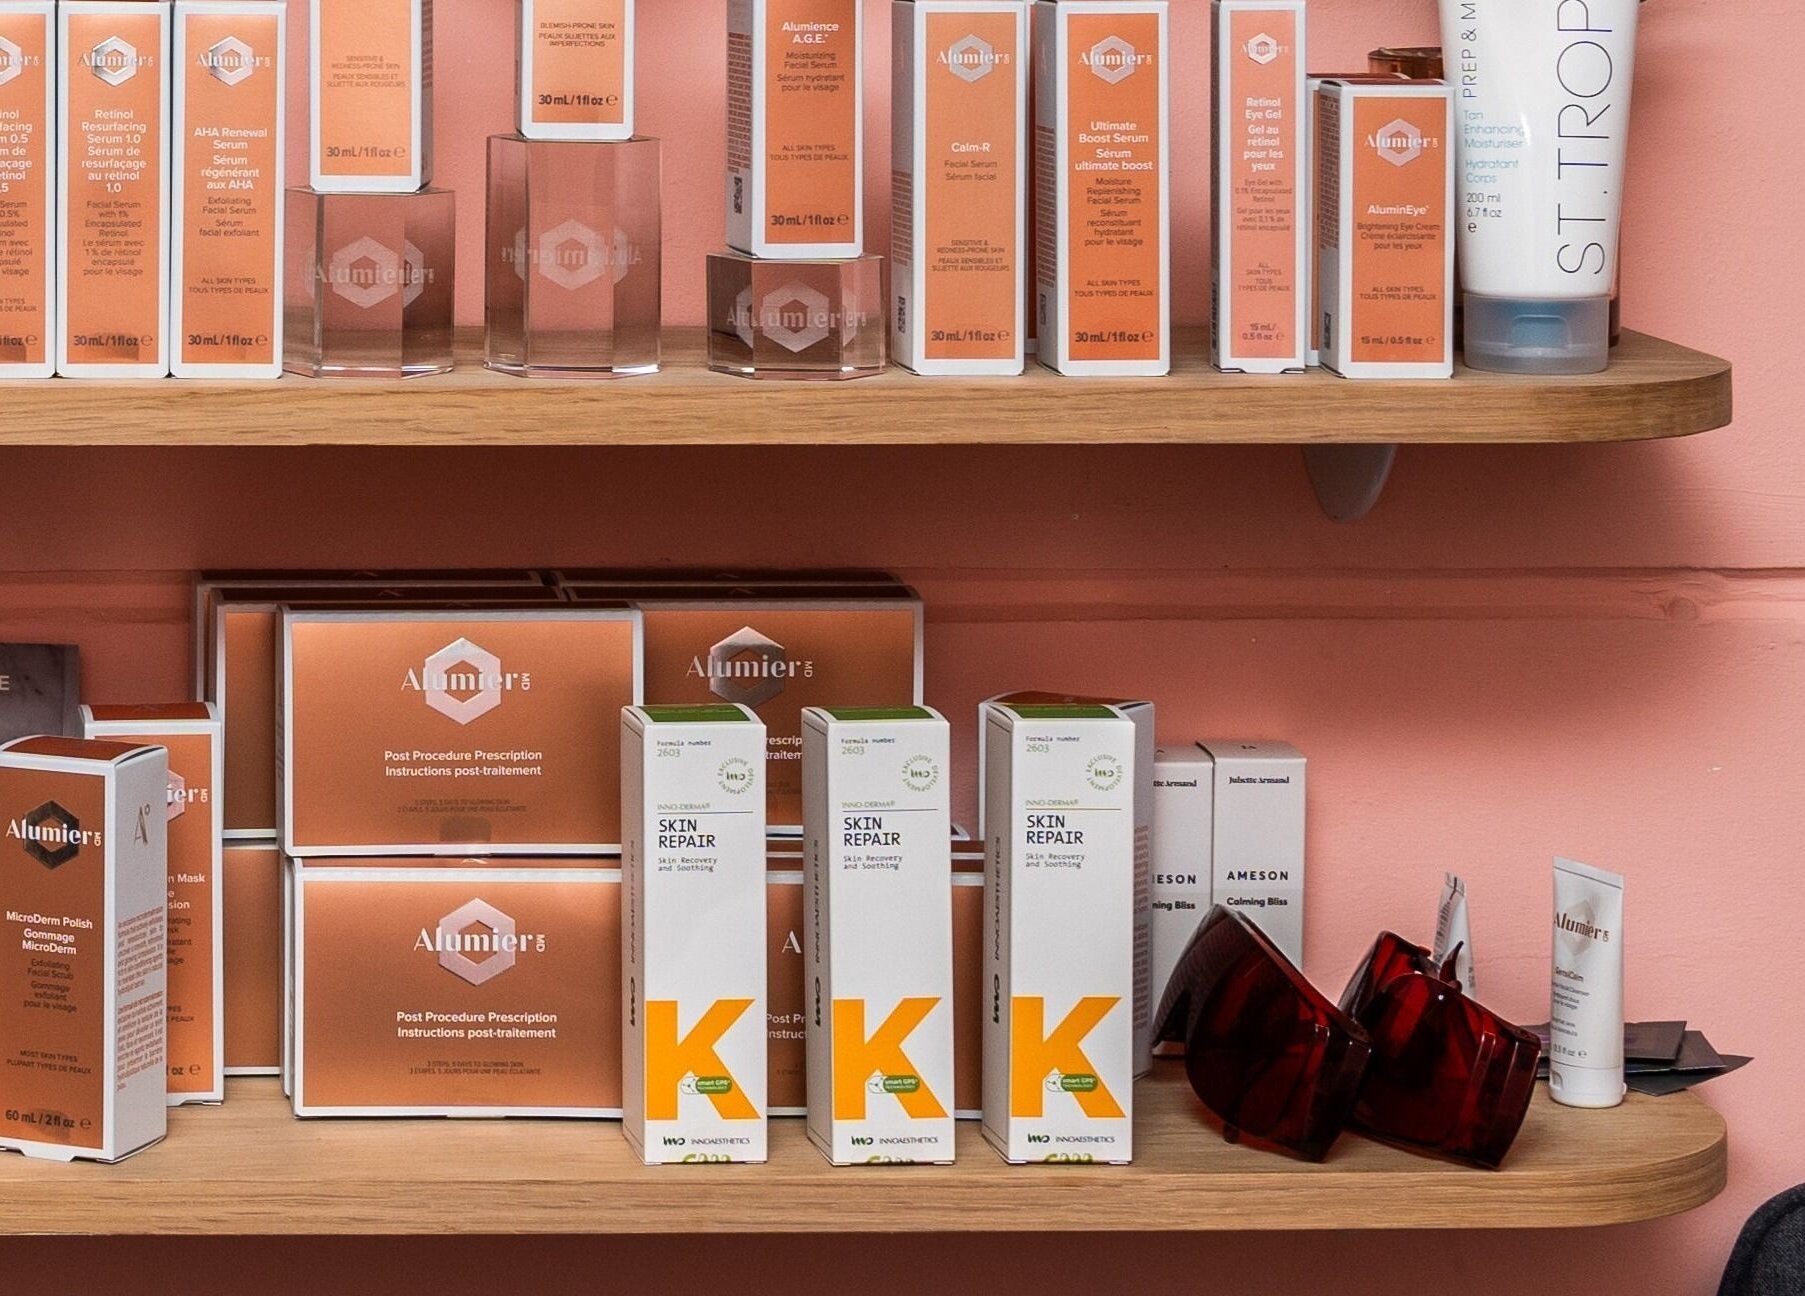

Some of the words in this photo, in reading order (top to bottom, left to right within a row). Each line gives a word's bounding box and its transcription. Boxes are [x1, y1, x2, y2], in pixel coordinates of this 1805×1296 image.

[781, 22, 839, 32] Alumience
[1461, 29, 1476, 41] &
[1462, 48, 1478, 98] PREP
[1246, 98, 1281, 107] Retinol
[1245, 110, 1262, 121] Eye
[1265, 110, 1282, 119] Gel
[1464, 110, 1483, 119] Tan
[1090, 121, 1137, 131] Ultimate
[1465, 125, 1525, 137] Enhancing
[10, 134, 28, 143] 0.5
[194, 128, 218, 137] AHA
[222, 128, 267, 137] Renewal
[1079, 133, 1110, 144] Boost
[1113, 133, 1149, 144] Serum
[213, 141, 248, 149] Serum
[951, 142, 991, 154] Calm-R
[1465, 160, 1518, 170] Hydratant
[1466, 173, 1497, 184] Corps
[1466, 193, 1484, 202] 200
[1487, 193, 1501, 202] ml
[385, 751, 409, 761] Post
[413, 751, 471, 760] Procedure
[475, 750, 542, 762] Prescription
[386, 766, 451, 776] Instructions
[455, 765, 541, 777] post-traitement
[659, 819, 696, 832] SKIN
[844, 817, 882, 830] SKIN
[1027, 815, 1065, 828] SKIN
[659, 835, 715, 848] REPAIR
[844, 833, 900, 846] REPAIR
[1027, 832, 1083, 844] REPAIR
[1227, 872, 1288, 880] AMESON
[1226, 897, 1264, 907] Calming
[1268, 898, 1287, 906] Bliss
[7, 911, 60, 925] MicroDerm
[63, 918, 92, 929] Polish
[24, 928, 75, 944] Gommage
[22, 940, 76, 954] MicroDerm
[397, 1012, 422, 1022] Post
[426, 1012, 485, 1022] Procedure
[488, 1012, 557, 1024] Prescription
[398, 1027, 464, 1037] Instructions
[468, 1027, 556, 1039] post-traitement
[646, 999, 762, 1120] K
[833, 997, 949, 1120] K
[1011, 996, 1126, 1118] K
